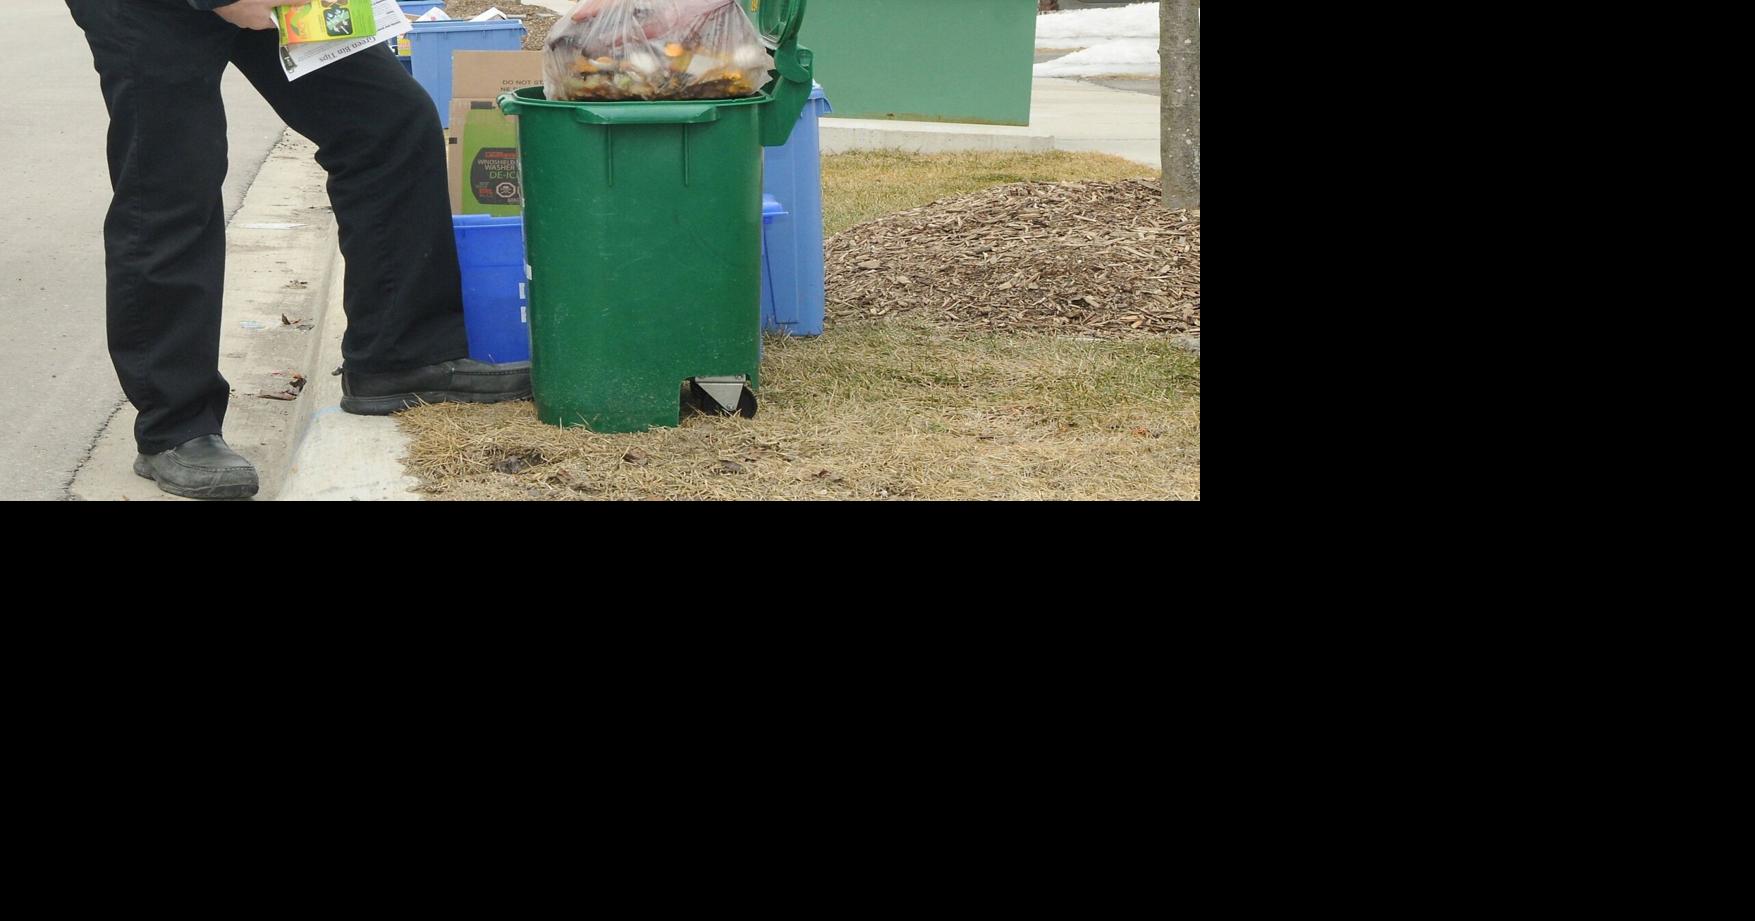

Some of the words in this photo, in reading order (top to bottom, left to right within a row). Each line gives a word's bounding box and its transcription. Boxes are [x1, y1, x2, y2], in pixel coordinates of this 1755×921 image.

[352, 36, 376, 49] Green
[337, 46, 351, 55] Bin
[319, 51, 336, 62] Tips
[489, 171, 518, 179] DE-IC
